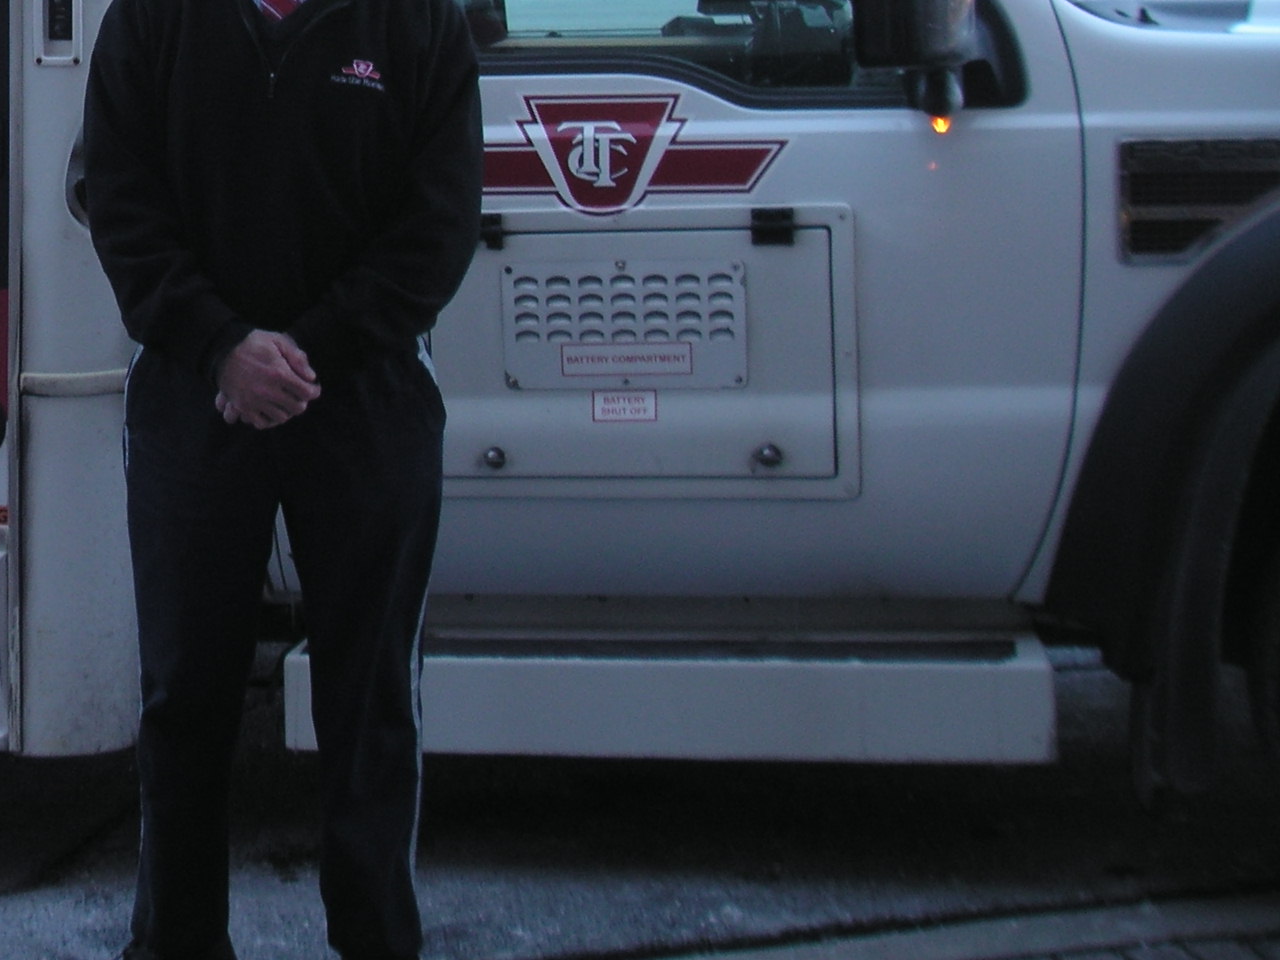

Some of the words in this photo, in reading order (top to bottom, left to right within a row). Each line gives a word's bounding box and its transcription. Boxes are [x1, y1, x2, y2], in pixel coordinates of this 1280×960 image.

[566, 355, 609, 365] BATTERY
[611, 354, 686, 364] COMPARTMENT
[603, 396, 646, 405] BATTERY
[601, 406, 627, 416] SHUT
[630, 406, 648, 416] OFF
